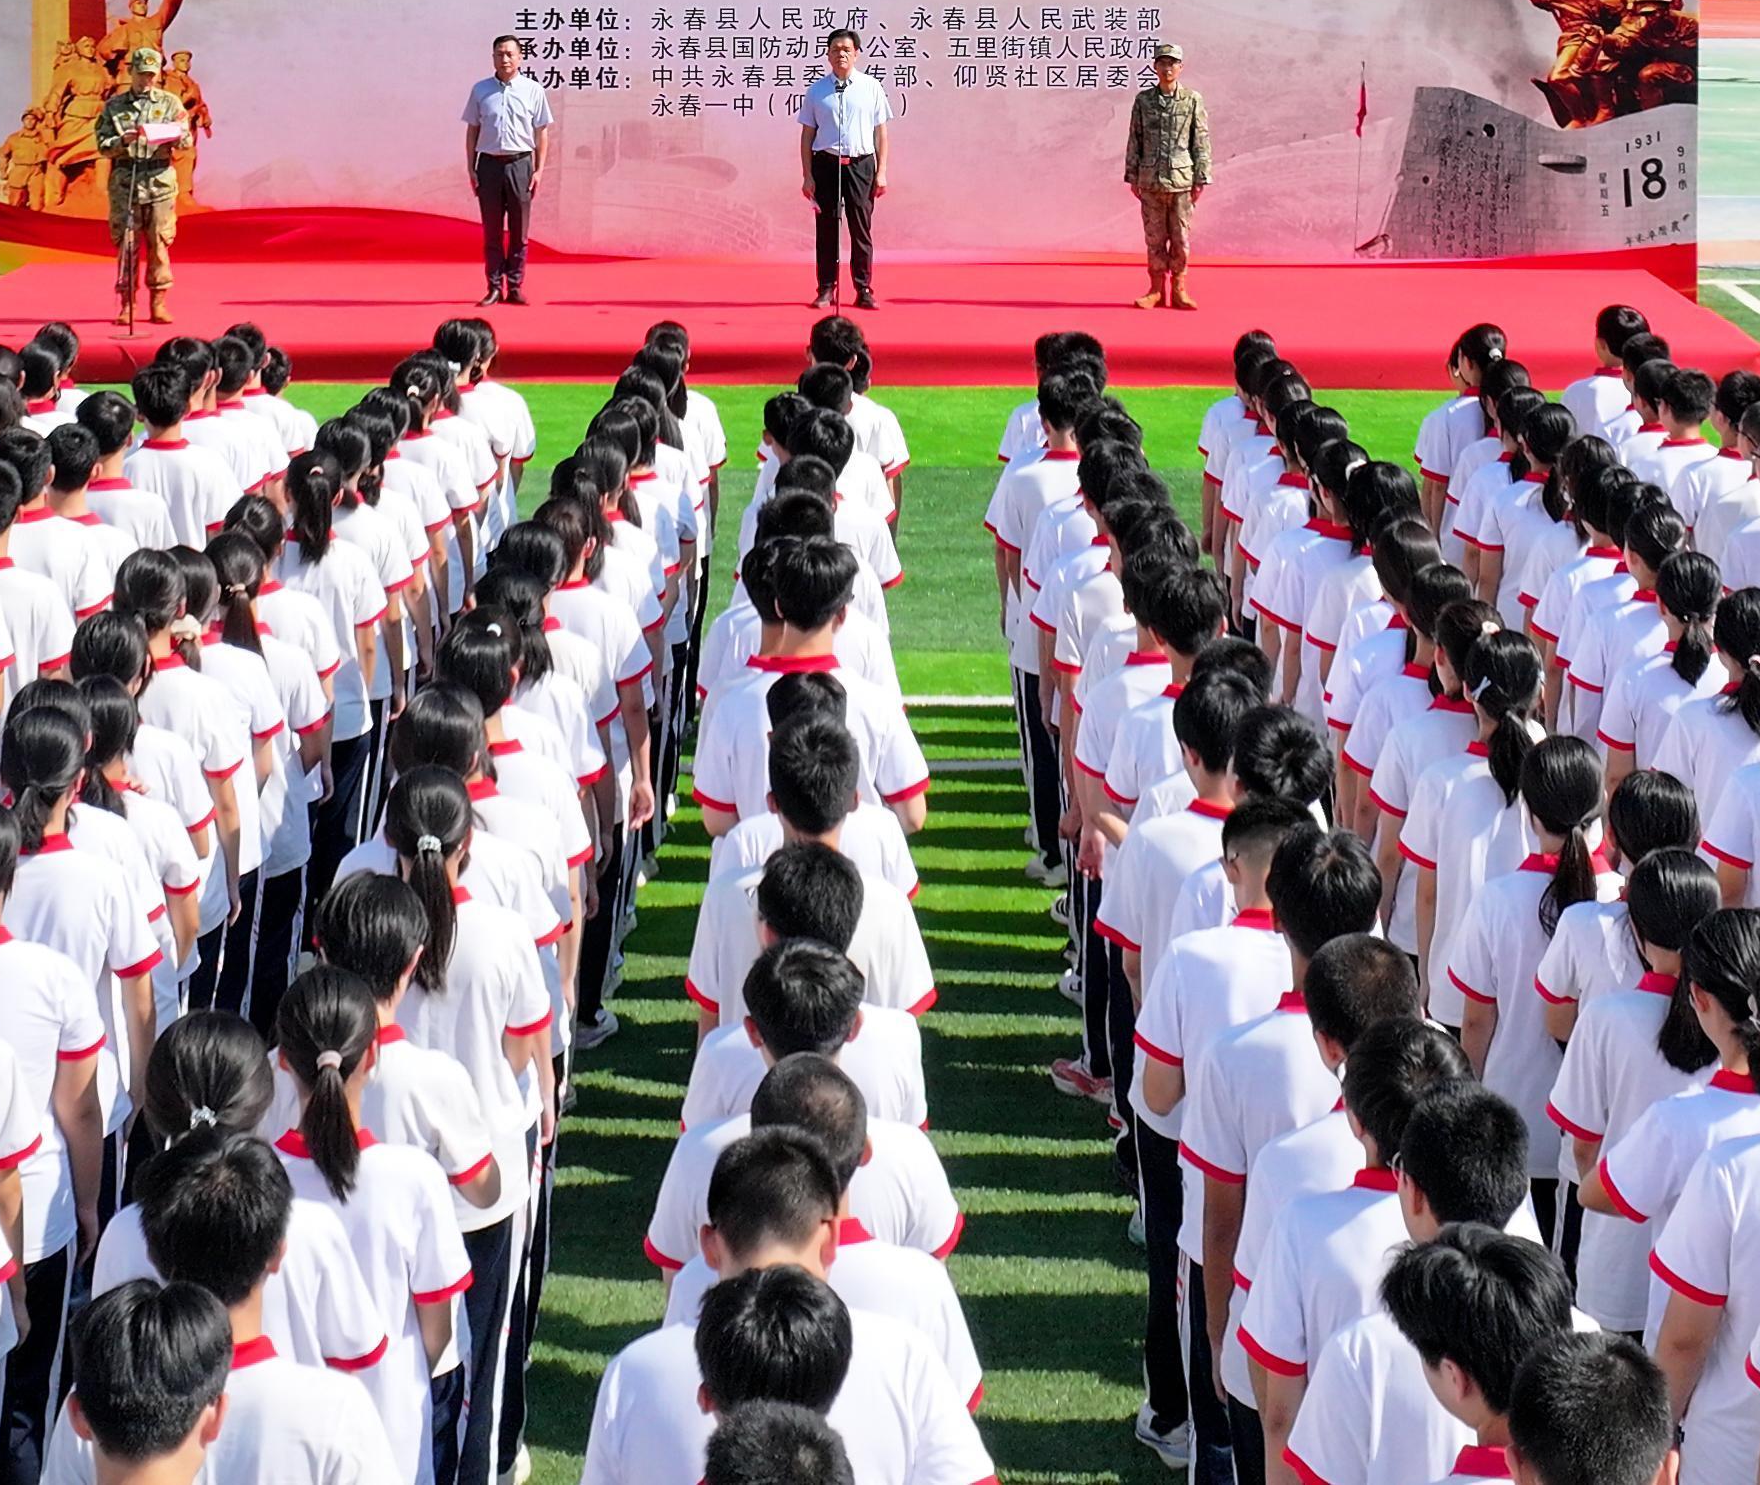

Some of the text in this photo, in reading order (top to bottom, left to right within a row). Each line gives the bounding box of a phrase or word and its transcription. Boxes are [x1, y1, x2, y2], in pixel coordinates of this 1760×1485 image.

[514, 7, 631, 31] 主办单位：
[650, 35, 1160, 61] 永春县国防动员公室、五里街镇人民政府
[652, 64, 1158, 89] 中共永春县委传部、仰贤社区居委会
[1625, 130, 1661, 153] 1931
[1623, 158, 1667, 208] 18
